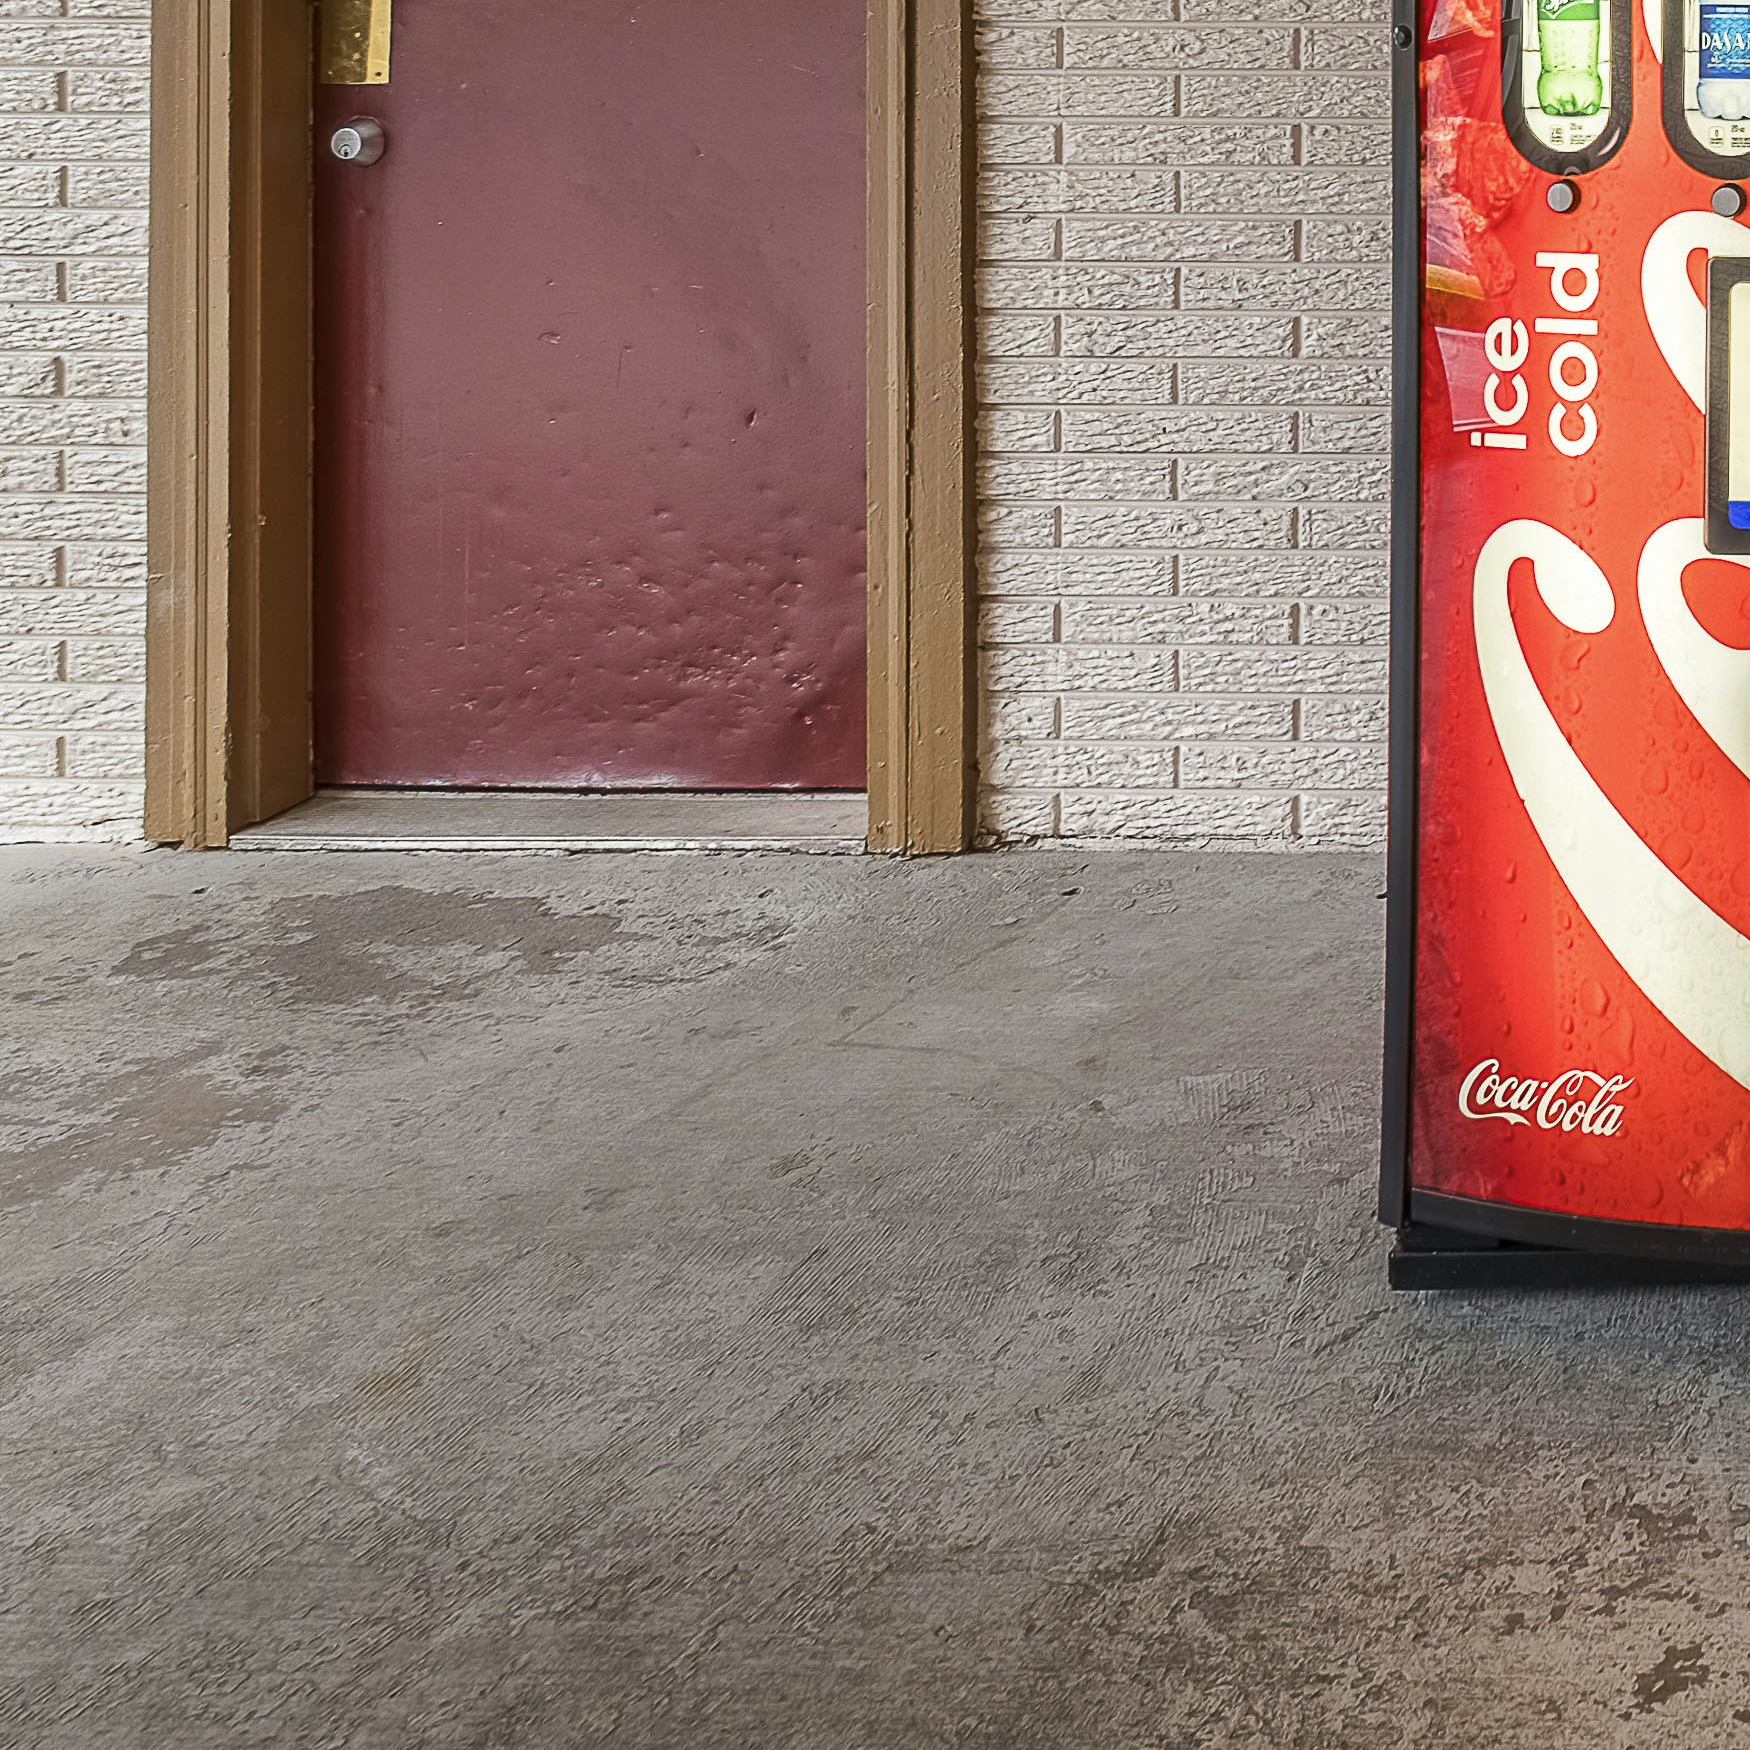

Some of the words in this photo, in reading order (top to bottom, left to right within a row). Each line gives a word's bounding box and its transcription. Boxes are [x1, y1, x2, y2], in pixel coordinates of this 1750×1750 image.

[1470, 316, 1530, 450] ice
[1534, 250, 1600, 458] cold
[1458, 1058, 1636, 1137] Coca-Cola
